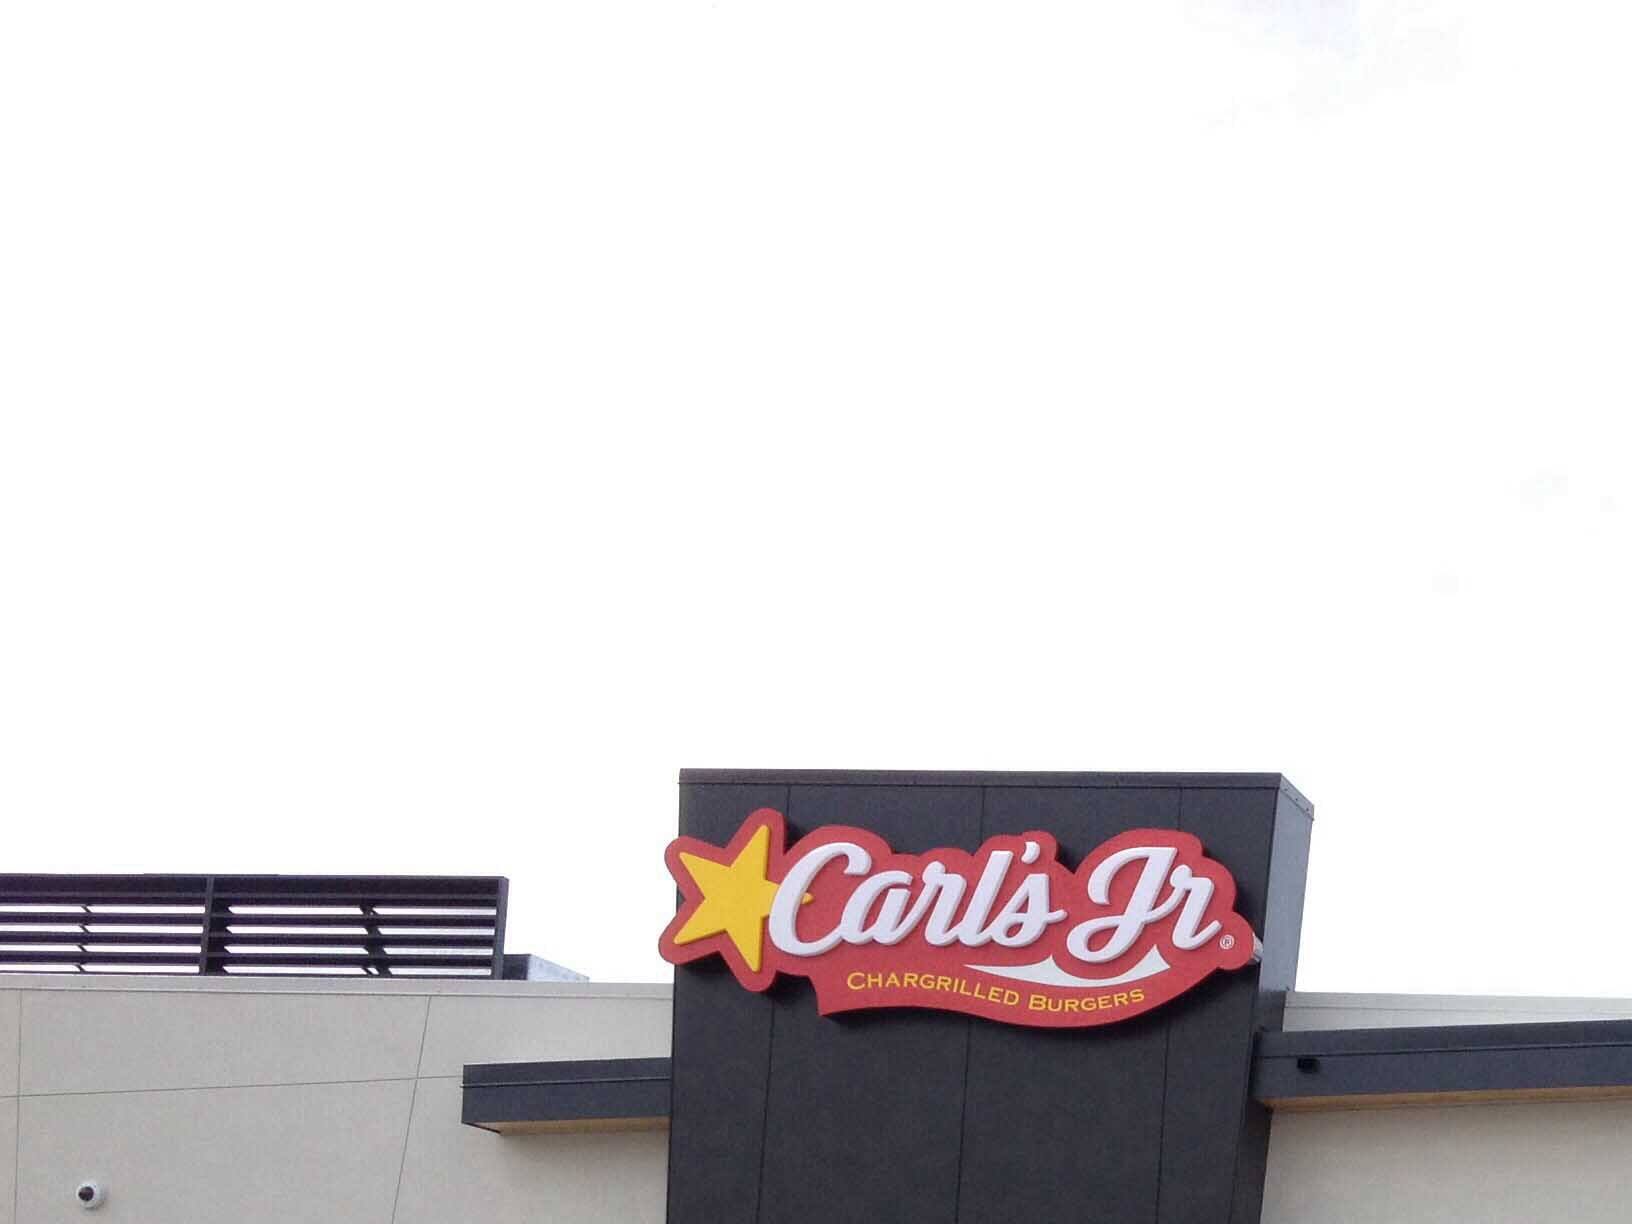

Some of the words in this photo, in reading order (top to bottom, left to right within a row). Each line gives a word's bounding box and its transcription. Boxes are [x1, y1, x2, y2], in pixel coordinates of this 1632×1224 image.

[768, 841, 1067, 957] Carl's
[846, 972, 1020, 1006] CHARGRILLED
[1027, 988, 1145, 1012] BURGERS
